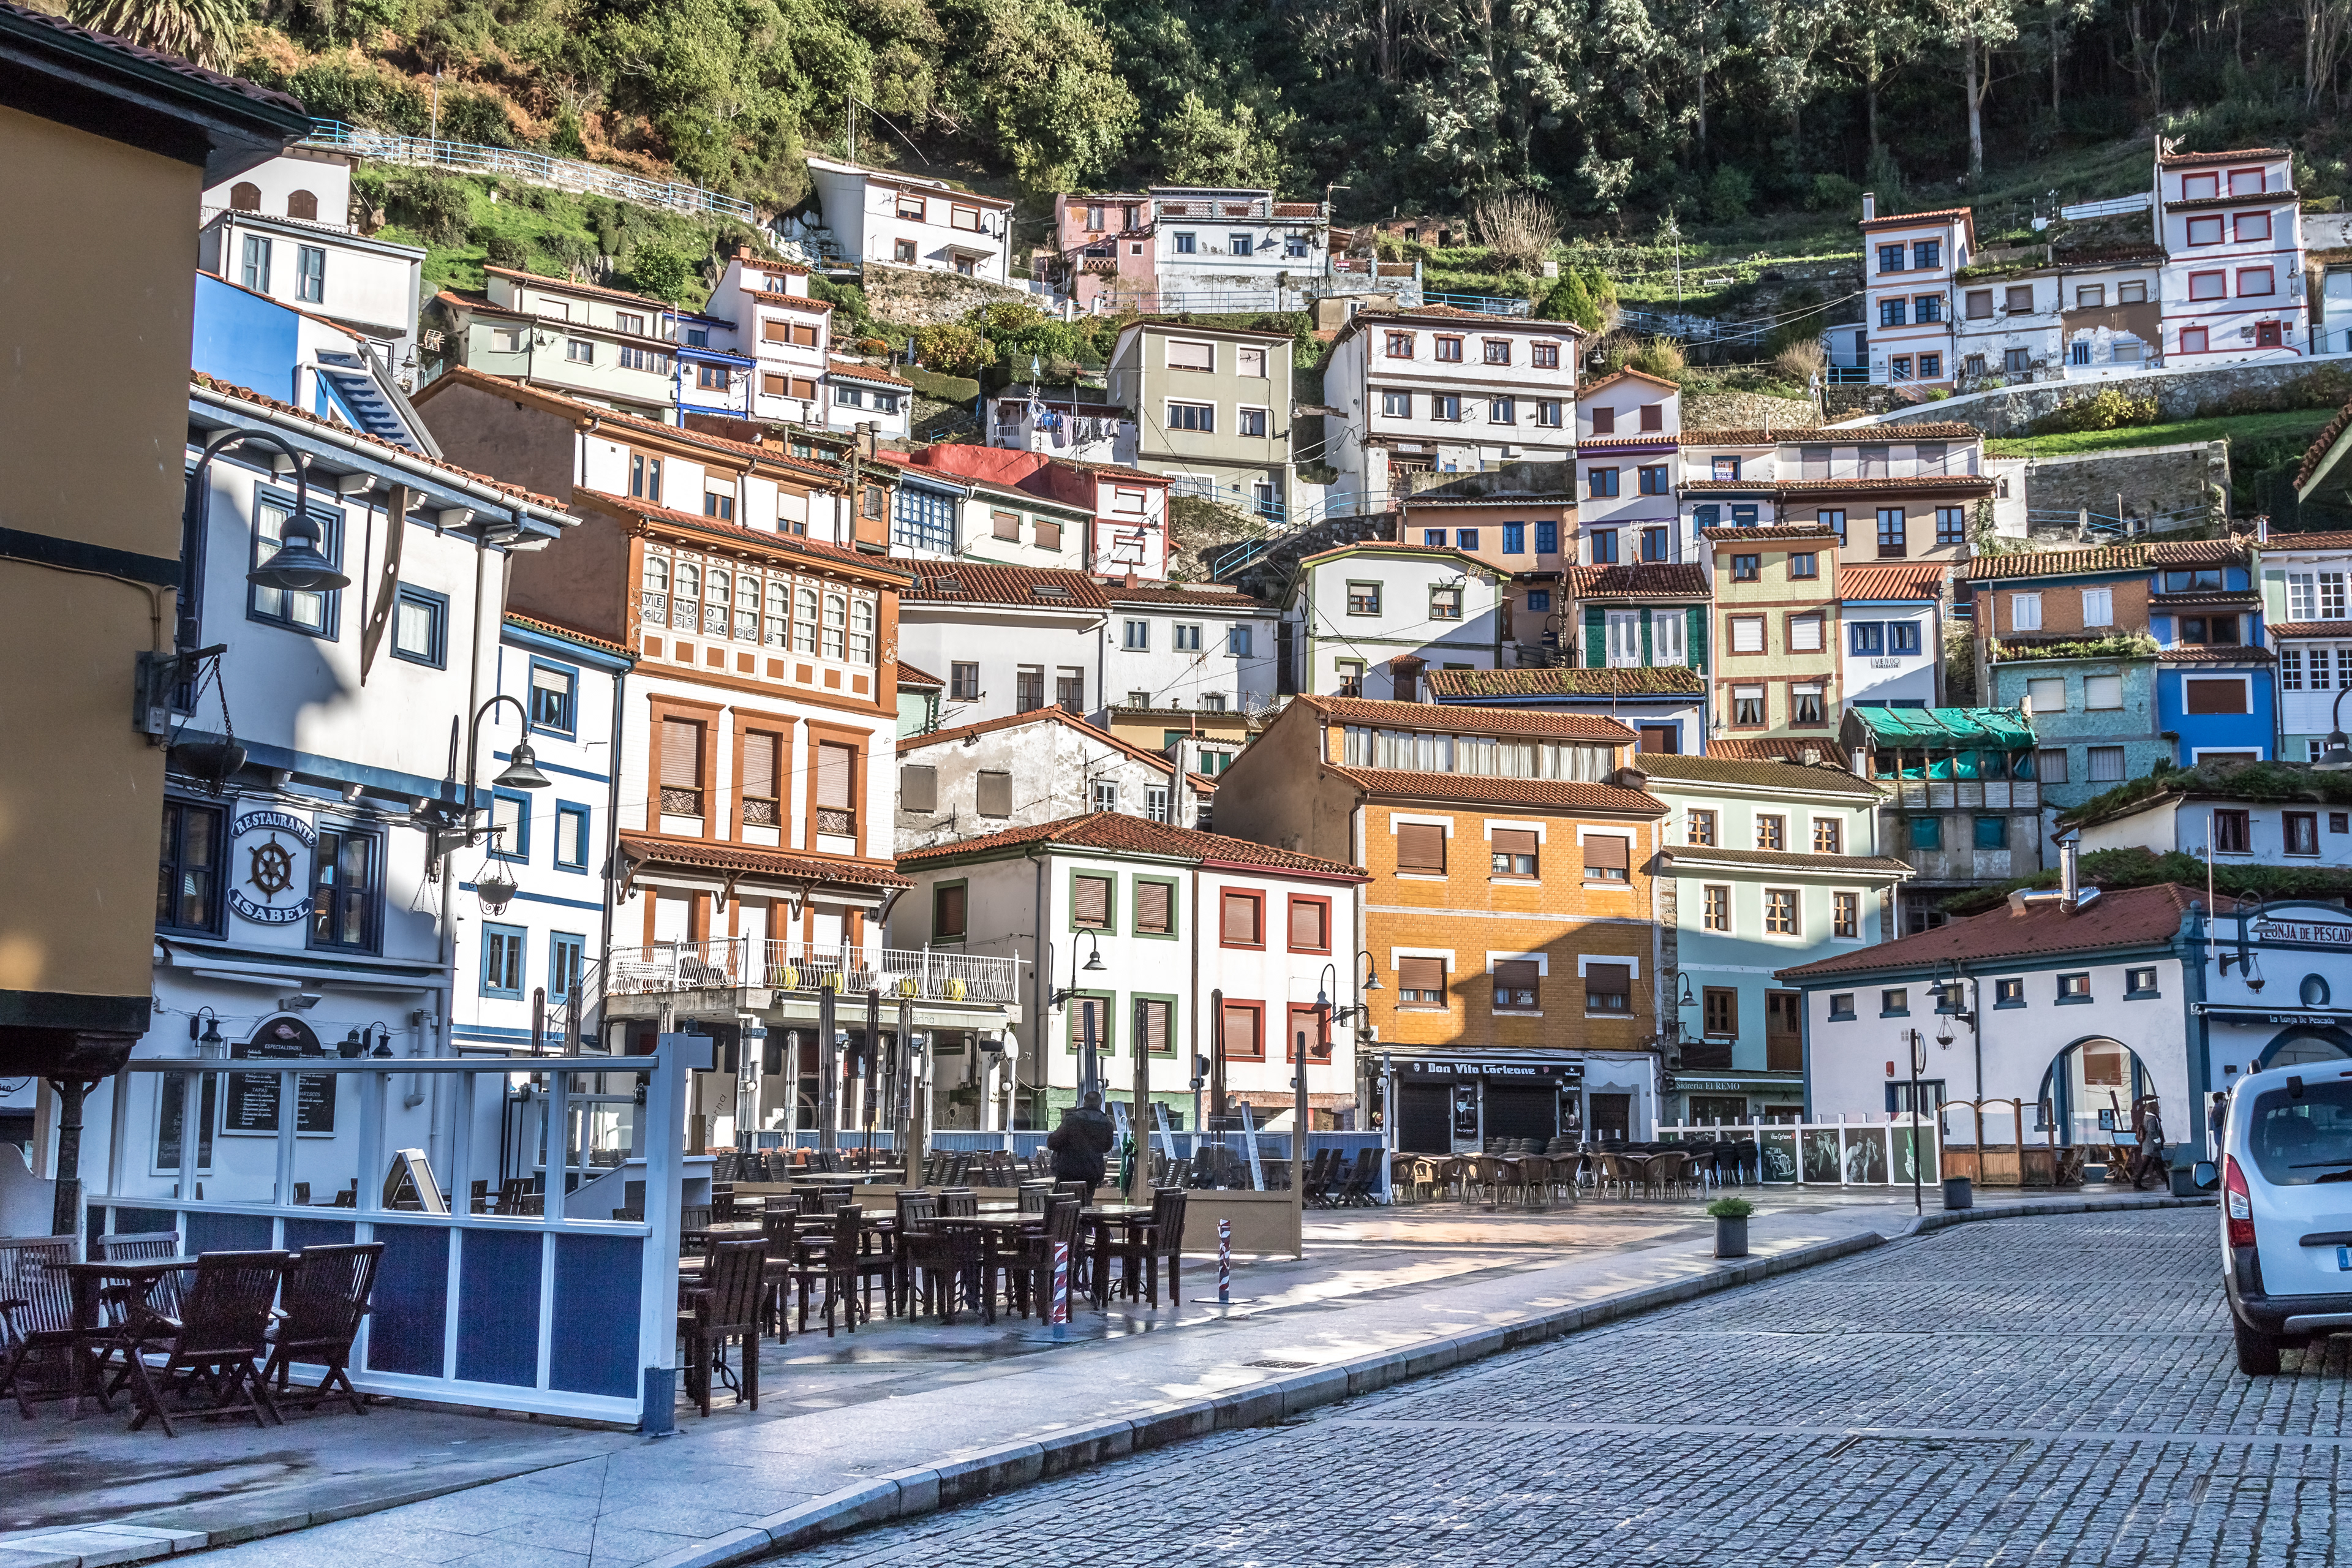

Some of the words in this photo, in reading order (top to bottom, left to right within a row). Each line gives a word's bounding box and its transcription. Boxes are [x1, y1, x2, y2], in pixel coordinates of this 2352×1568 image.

[644, 594, 715, 618] VENDO
[235, 812, 315, 844] RESTAURANTE
[233, 892, 309, 922] ISABEL
[2300, 927, 2310, 940] DE
[2314, 927, 2352, 942] PESCAD
[861, 1011, 884, 1021] Cé
[2280, 1015, 2297, 1025] Lonja
[1428, 1063, 1450, 1073] Don
[1454, 1063, 1480, 1074] Vito
[1482, 1065, 1536, 1074] Corleone
